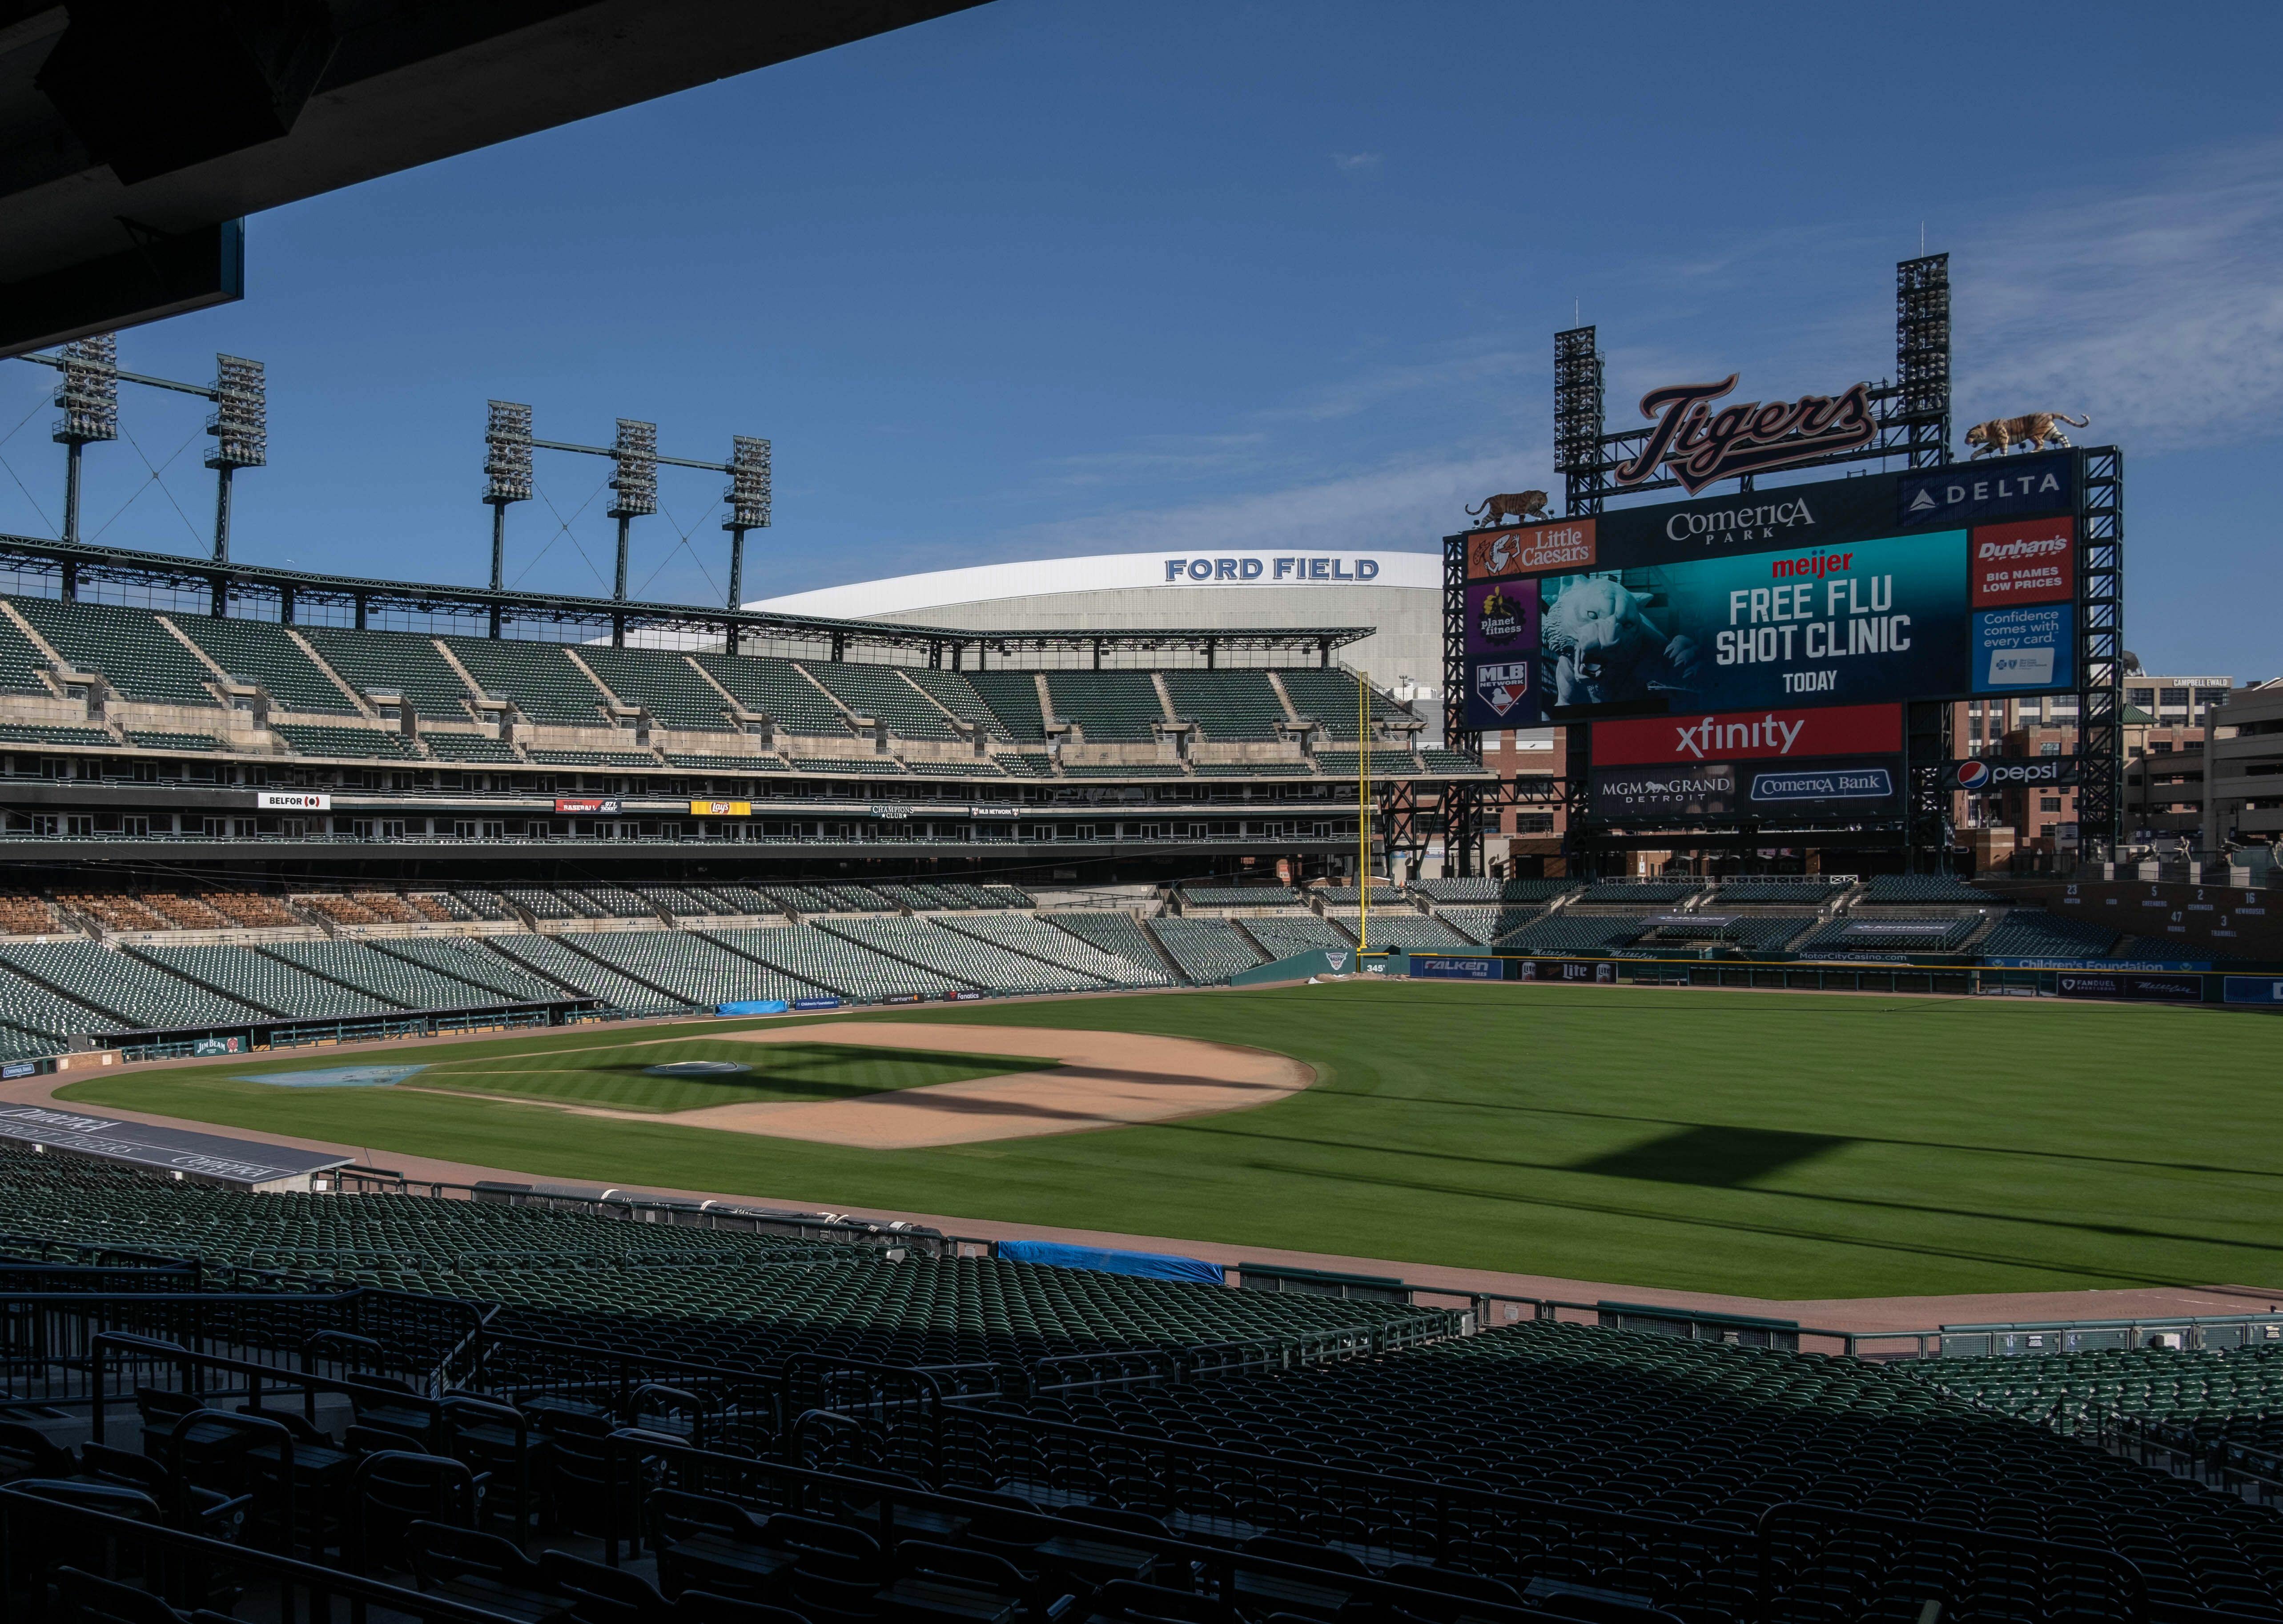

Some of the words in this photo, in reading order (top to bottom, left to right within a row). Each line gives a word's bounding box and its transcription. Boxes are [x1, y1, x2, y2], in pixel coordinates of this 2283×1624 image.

[1614, 372, 1878, 497] Tigers
[1947, 473, 2060, 504] DELTA
[1535, 527, 1582, 549] Little
[1705, 527, 1773, 545] PARK
[1979, 535, 2067, 558] Dunham's
[1522, 546, 1589, 566] Caesars
[1987, 551, 2059, 562] SPORTS
[1165, 559, 1263, 581] FORD
[1273, 558, 1379, 581] FIELD
[1772, 549, 1853, 579] meijer
[1986, 572, 2009, 582] BIG
[2013, 567, 2058, 579] NAMES
[1983, 582, 2011, 592] LOW
[2015, 577, 2062, 590] PRICES
[1729, 583, 1813, 625] FREE
[1828, 575, 1892, 616] FLU
[1481, 616, 1515, 630] planet
[1984, 611, 2059, 624] Confidence
[1486, 624, 1522, 635] fitness
[1984, 626, 2026, 635] comes
[2031, 620, 2058, 632] with
[1716, 624, 1798, 666] SHOT
[1806, 614, 1911, 659] CLINIC
[1984, 637, 2020, 647] every
[2024, 631, 2055, 644] card.
[1479, 665, 1524, 682] MLB
[1480, 679, 1523, 687] NETWORK
[1783, 670, 1837, 693] TODAY
[1675, 713, 1804, 758] xfinity
[1993, 762, 2057, 784] pepsi
[1602, 782, 1644, 796] MGM
[1668, 778, 1730, 793] GRAND
[1839, 775, 1880, 790] Bank
[269, 797, 302, 805] BELFOR
[1626, 794, 1705, 803] DETROIT
[713, 802, 729, 813] Lay's
[872, 806, 914, 814] CHAMPIONS
[2067, 885, 2078, 895] 23
[2152, 886, 2157, 896] 5
[2198, 889, 2203, 900] 2
[2246, 892, 2255, 904] 16
[2171, 911, 2182, 922] 47
[2221, 915, 2227, 926] 3
[1800, 953, 1906, 961] MotorCityCasino.com
[1425, 961, 1488, 971] FALKEN
[1563, 964, 1587, 979] Lite
[2019, 960, 2082, 969] Children's
[2086, 961, 2163, 971] Foundation
[197, 1041, 209, 1053] JIM
[209, 1039, 226, 1051] BEAM
